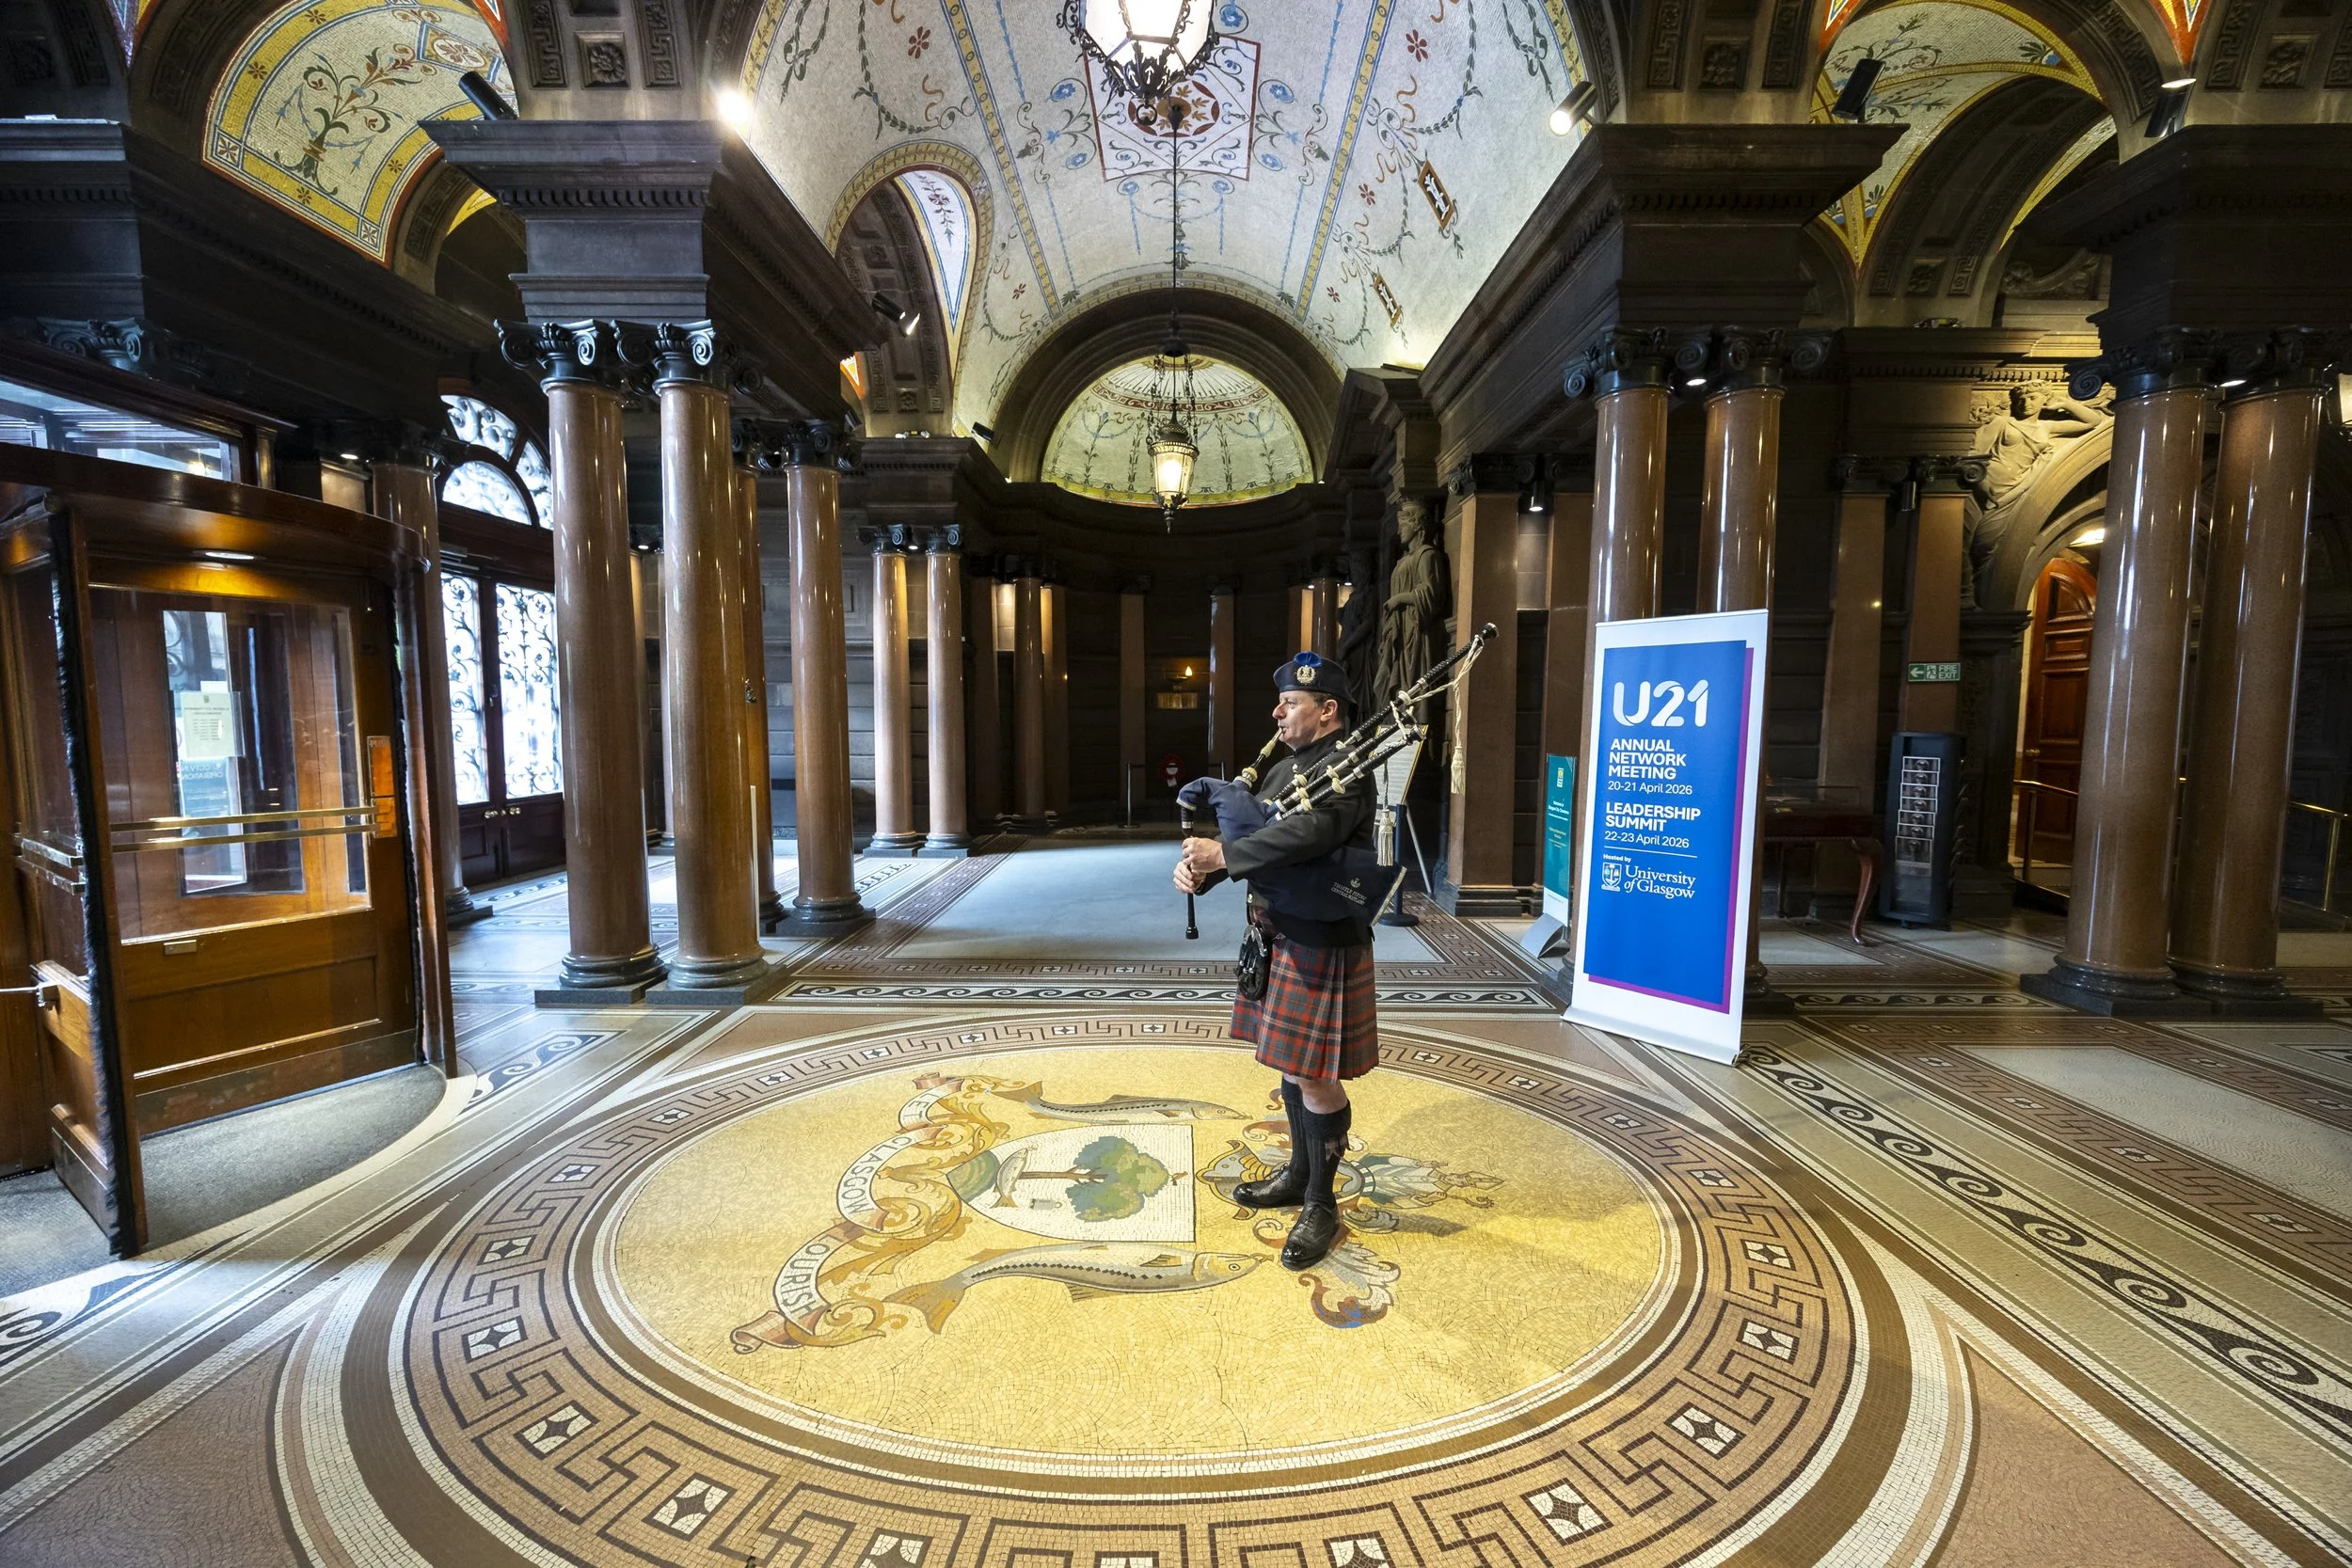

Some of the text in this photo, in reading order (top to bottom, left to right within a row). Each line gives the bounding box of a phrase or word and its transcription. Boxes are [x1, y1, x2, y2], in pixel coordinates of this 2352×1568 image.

[1613, 679, 1708, 727] U21
[1610, 737, 1675, 752] ANNUAL
[1609, 752, 1687, 767] NETWORK
[1608, 765, 1677, 780] MEETING
[1607, 781, 1693, 796] 20-21 April 2026
[1605, 801, 1701, 820] LEADERSHIP
[1605, 816, 1667, 832] SUMMIT
[1604, 831, 1690, 848] 22-23 April 2026
[1602, 853, 1624, 863] Hosted
[1625, 864, 1697, 890] University
[1623, 878, 1639, 894] of
[1636, 879, 1695, 899] Glasgow
[903, 1093, 940, 1119] LET
